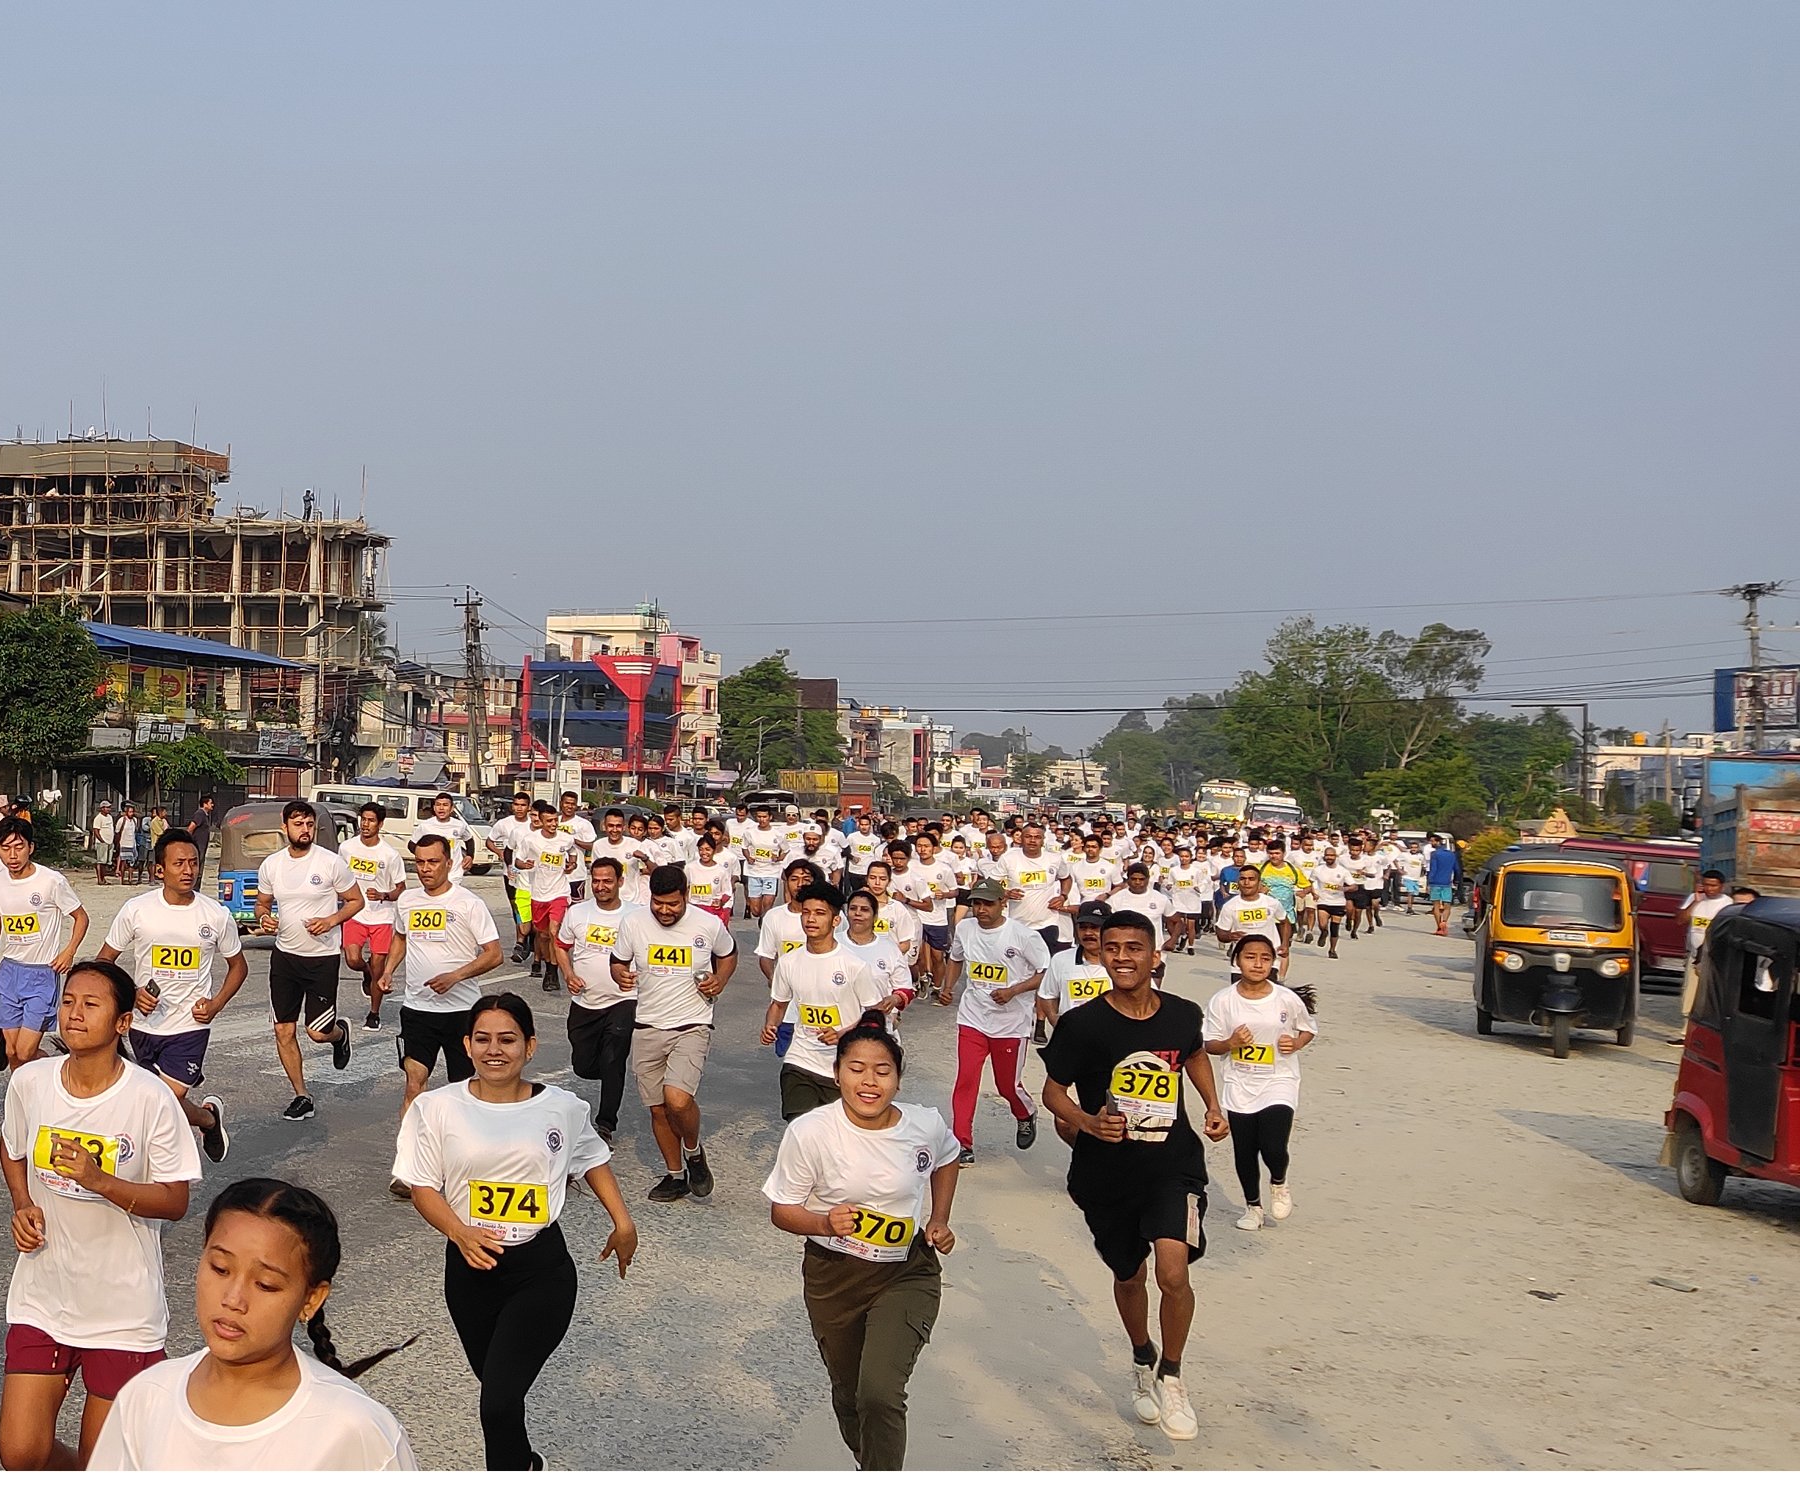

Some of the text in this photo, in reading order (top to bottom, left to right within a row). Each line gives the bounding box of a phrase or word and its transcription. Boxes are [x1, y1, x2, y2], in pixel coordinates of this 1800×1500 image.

[353, 859, 375, 873] 252
[545, 853, 561, 866] 513
[694, 885, 708, 895] 171
[1088, 879, 1103, 888] 381
[412, 912, 441, 928] 360
[1242, 909, 1263, 921] 518
[6, 916, 35, 933] 249
[160, 947, 192, 967] 210
[653, 948, 686, 964] 441
[972, 963, 1004, 982] 407
[1073, 981, 1104, 998] 367
[807, 1007, 833, 1025] 316
[1118, 1071, 1171, 1098] 378
[478, 1186, 539, 1218] 374
